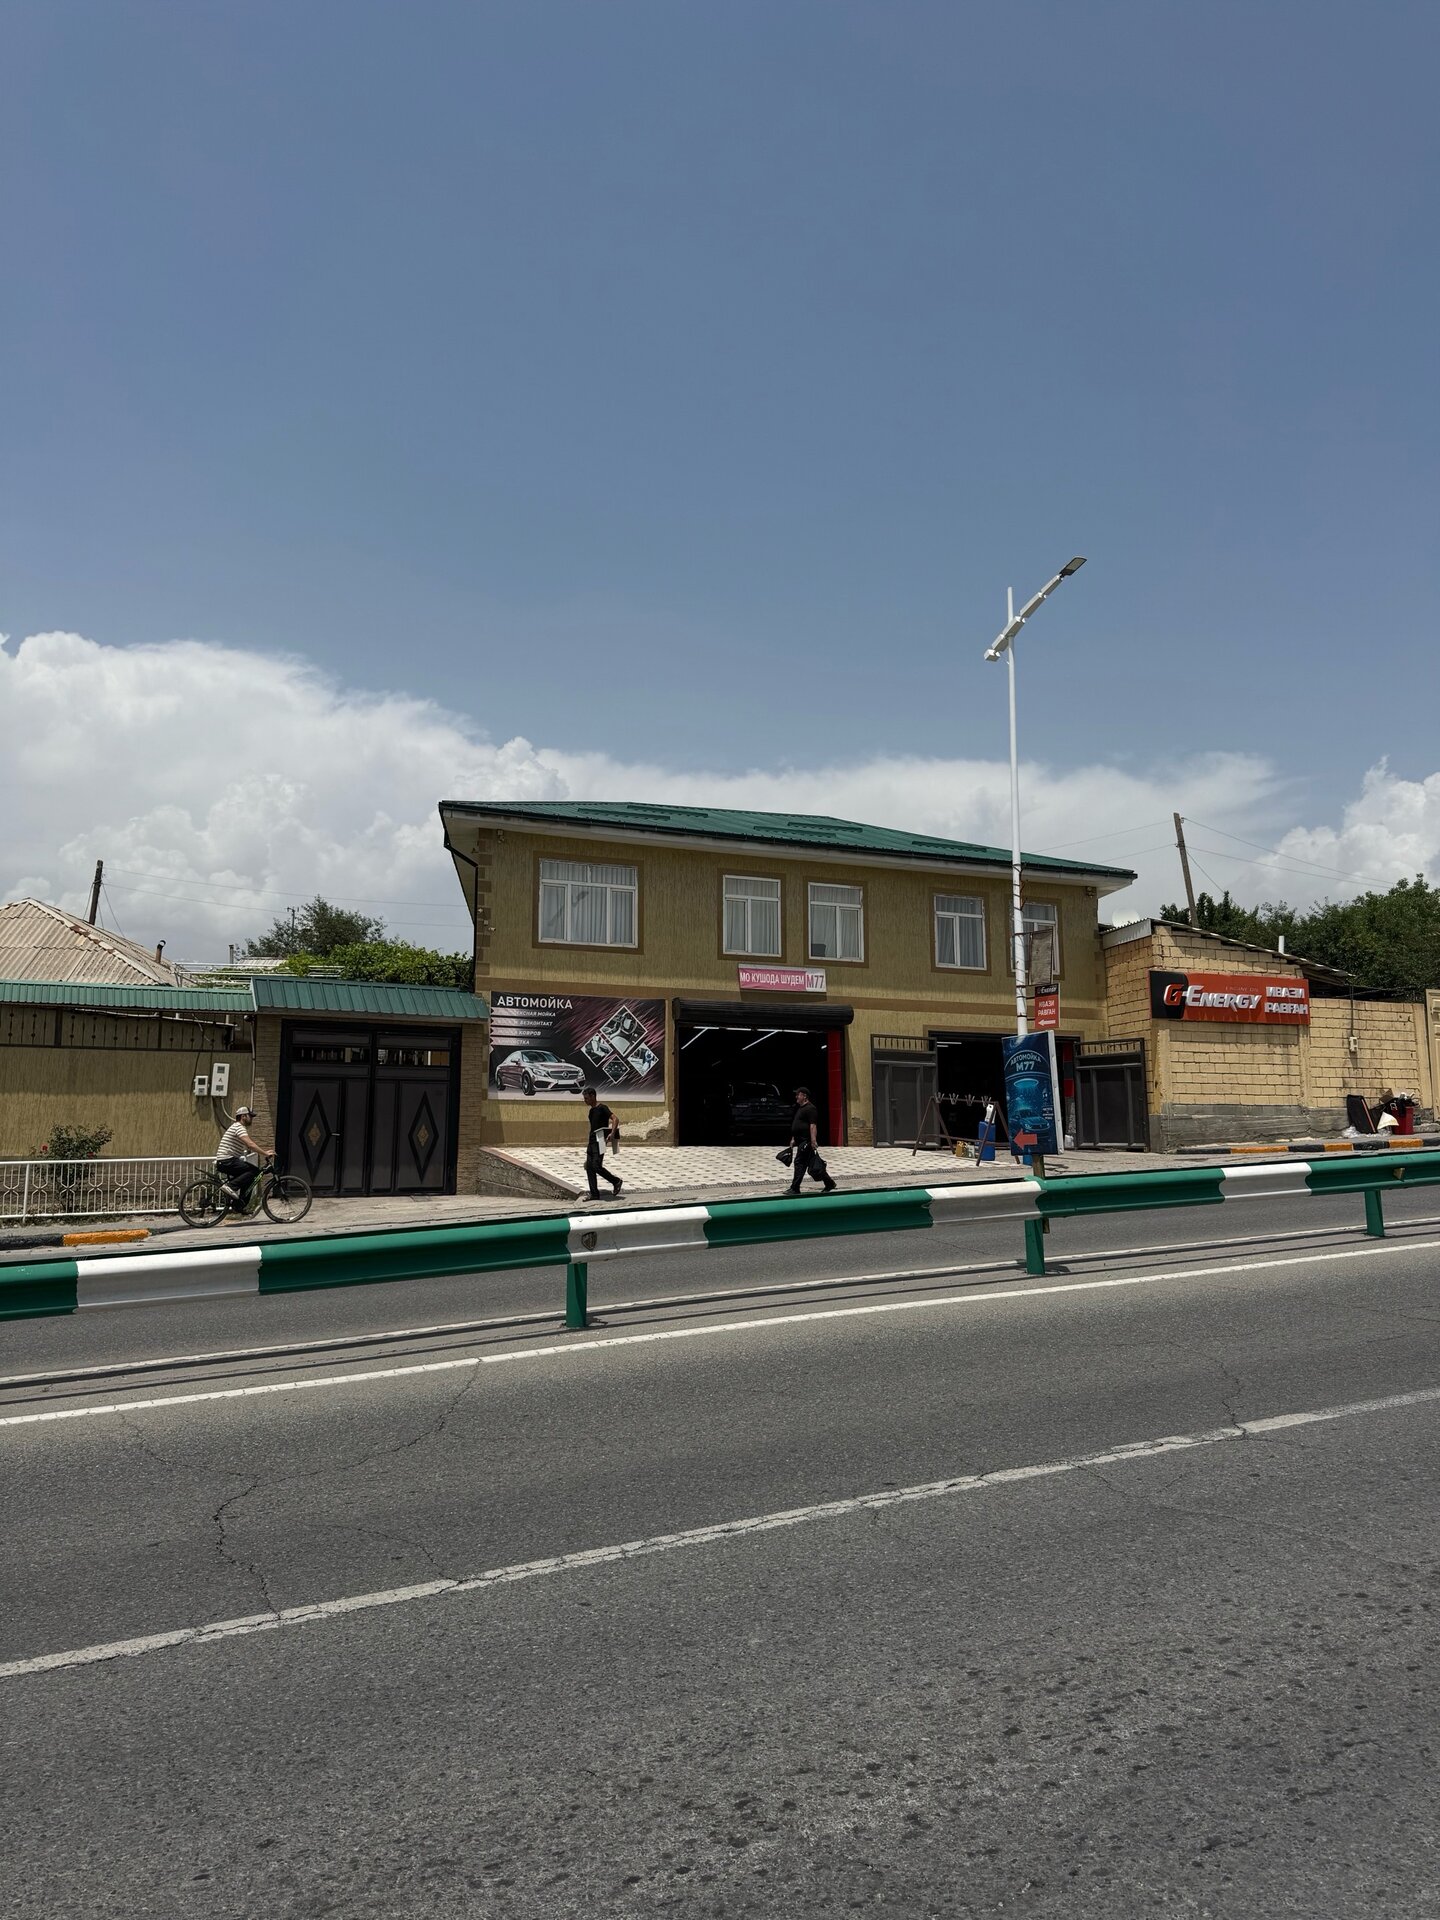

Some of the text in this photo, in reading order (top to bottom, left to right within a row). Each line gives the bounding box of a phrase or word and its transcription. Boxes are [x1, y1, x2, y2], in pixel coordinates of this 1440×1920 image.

[740, 972, 751, 982] МО
[751, 973, 780, 986] КУШОДА
[780, 975, 805, 987] ШУДЕМ
[1265, 986, 1305, 998] ИВАЗИ
[497, 995, 573, 1010] АВТОМОЙКА
[1010, 1053, 1042, 1066] АВТОМОЙКА
